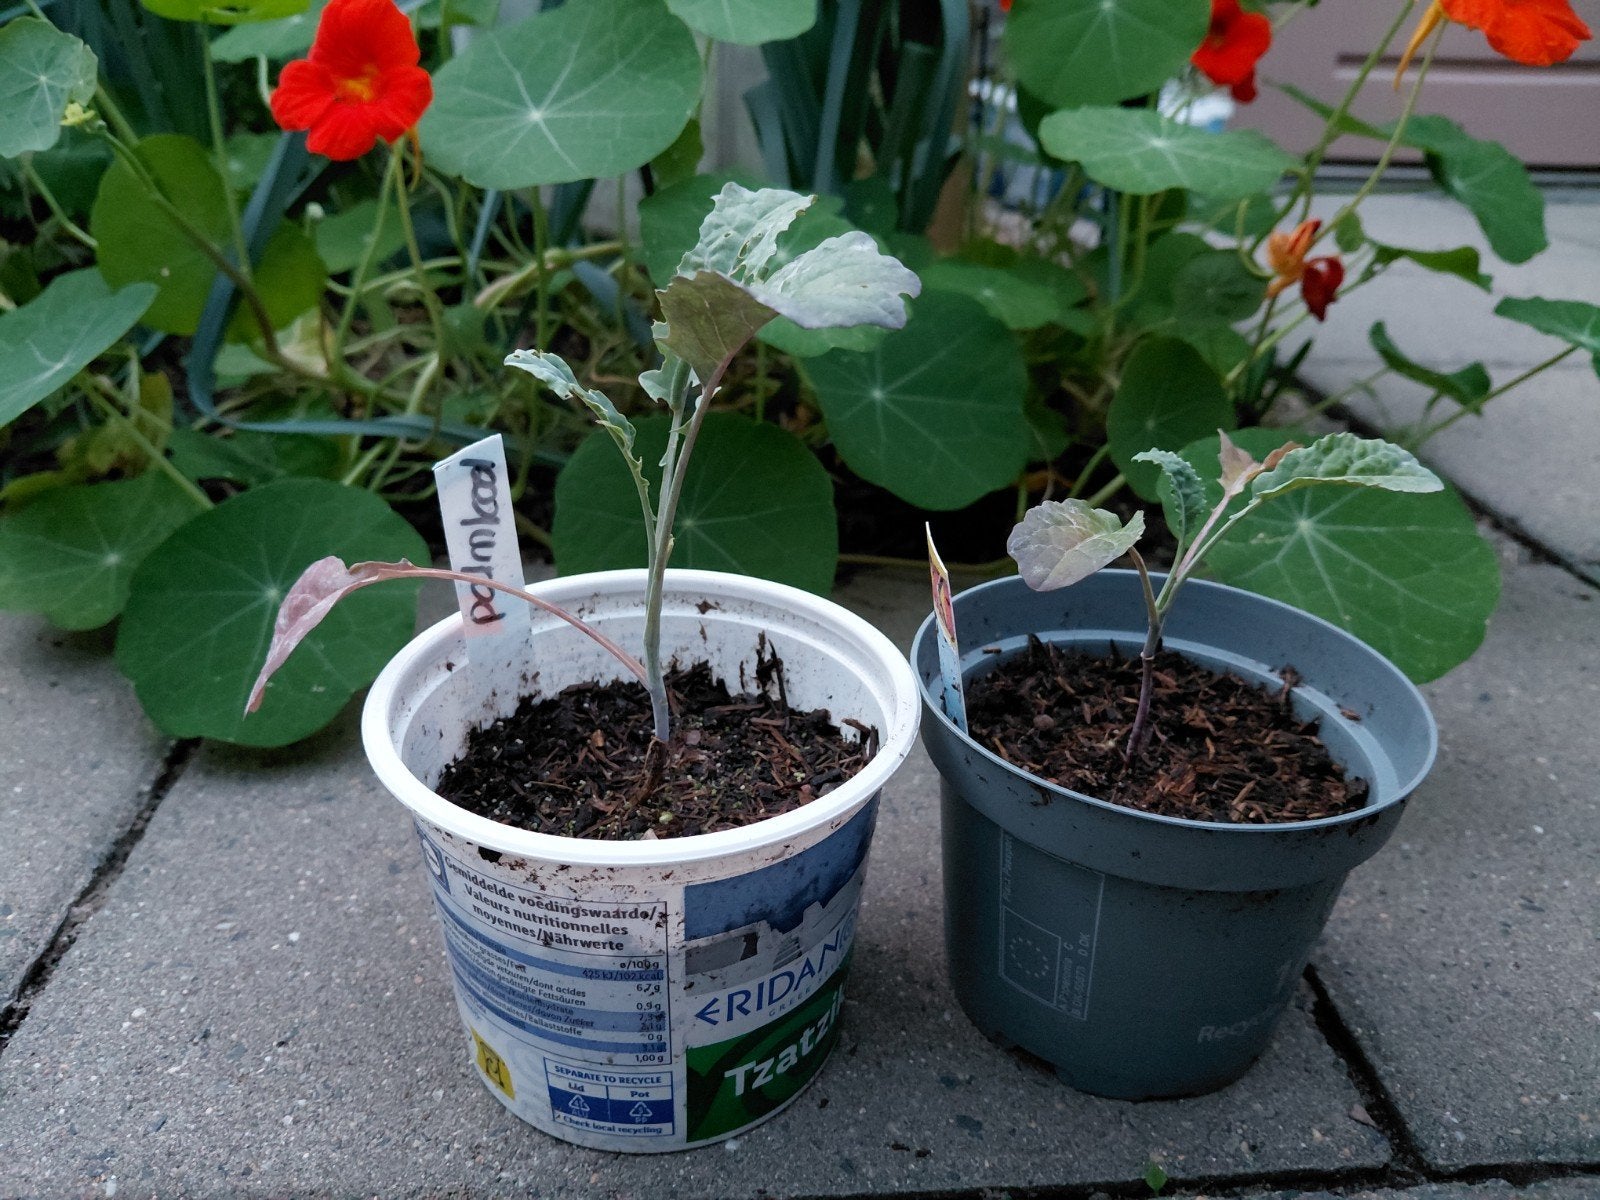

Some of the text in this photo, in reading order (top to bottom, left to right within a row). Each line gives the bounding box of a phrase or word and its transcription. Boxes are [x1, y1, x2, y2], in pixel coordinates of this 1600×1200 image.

[445, 856, 515, 901] Gemiddelde
[464, 883, 511, 914] Valeurs
[513, 908, 629, 935] nutritionnelles
[473, 904, 625, 951] moyennes/Nährwerte
[538, 987, 586, 1007] Fettsäuren
[555, 985, 586, 998] acides
[635, 1054, 655, 1063] 1,00
[555, 1065, 662, 1085] SEPARATE TO RECYCLE
[568, 1082, 585, 1093] Lid
[630, 1090, 650, 1098] Pot
[563, 1115, 663, 1134] Check local recycling
